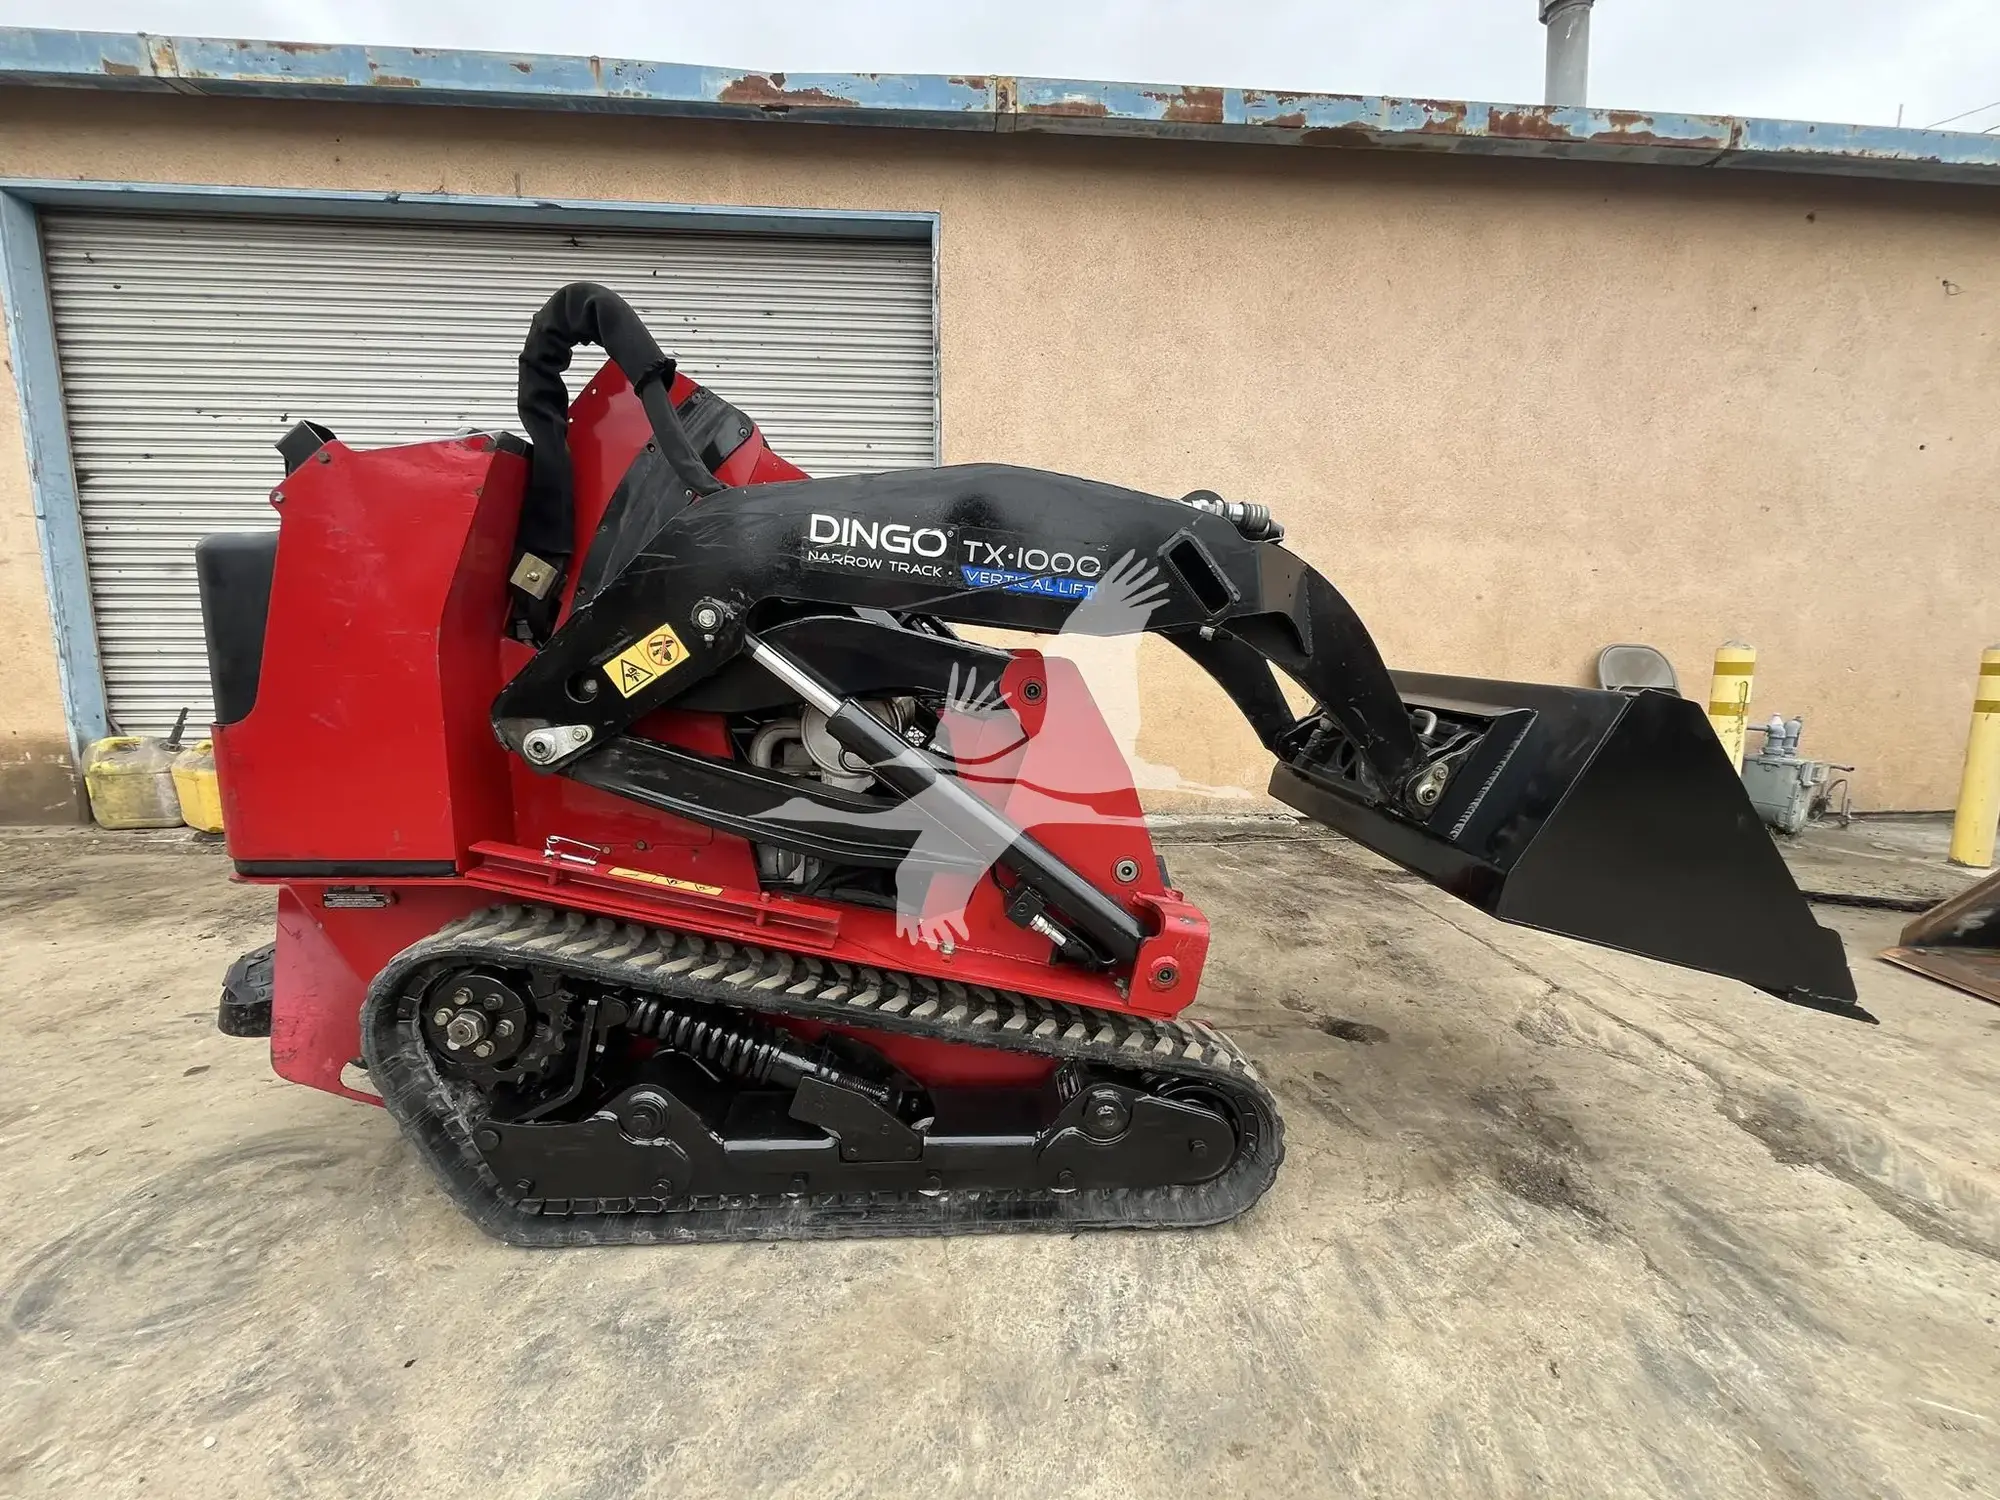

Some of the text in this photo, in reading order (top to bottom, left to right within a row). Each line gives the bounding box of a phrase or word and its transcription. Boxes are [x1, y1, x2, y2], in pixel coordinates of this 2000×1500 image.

[809, 513, 947, 557] DINGO
[807, 550, 943, 577] NARROW TRACK
[1059, 582, 1095, 596] LIFT
